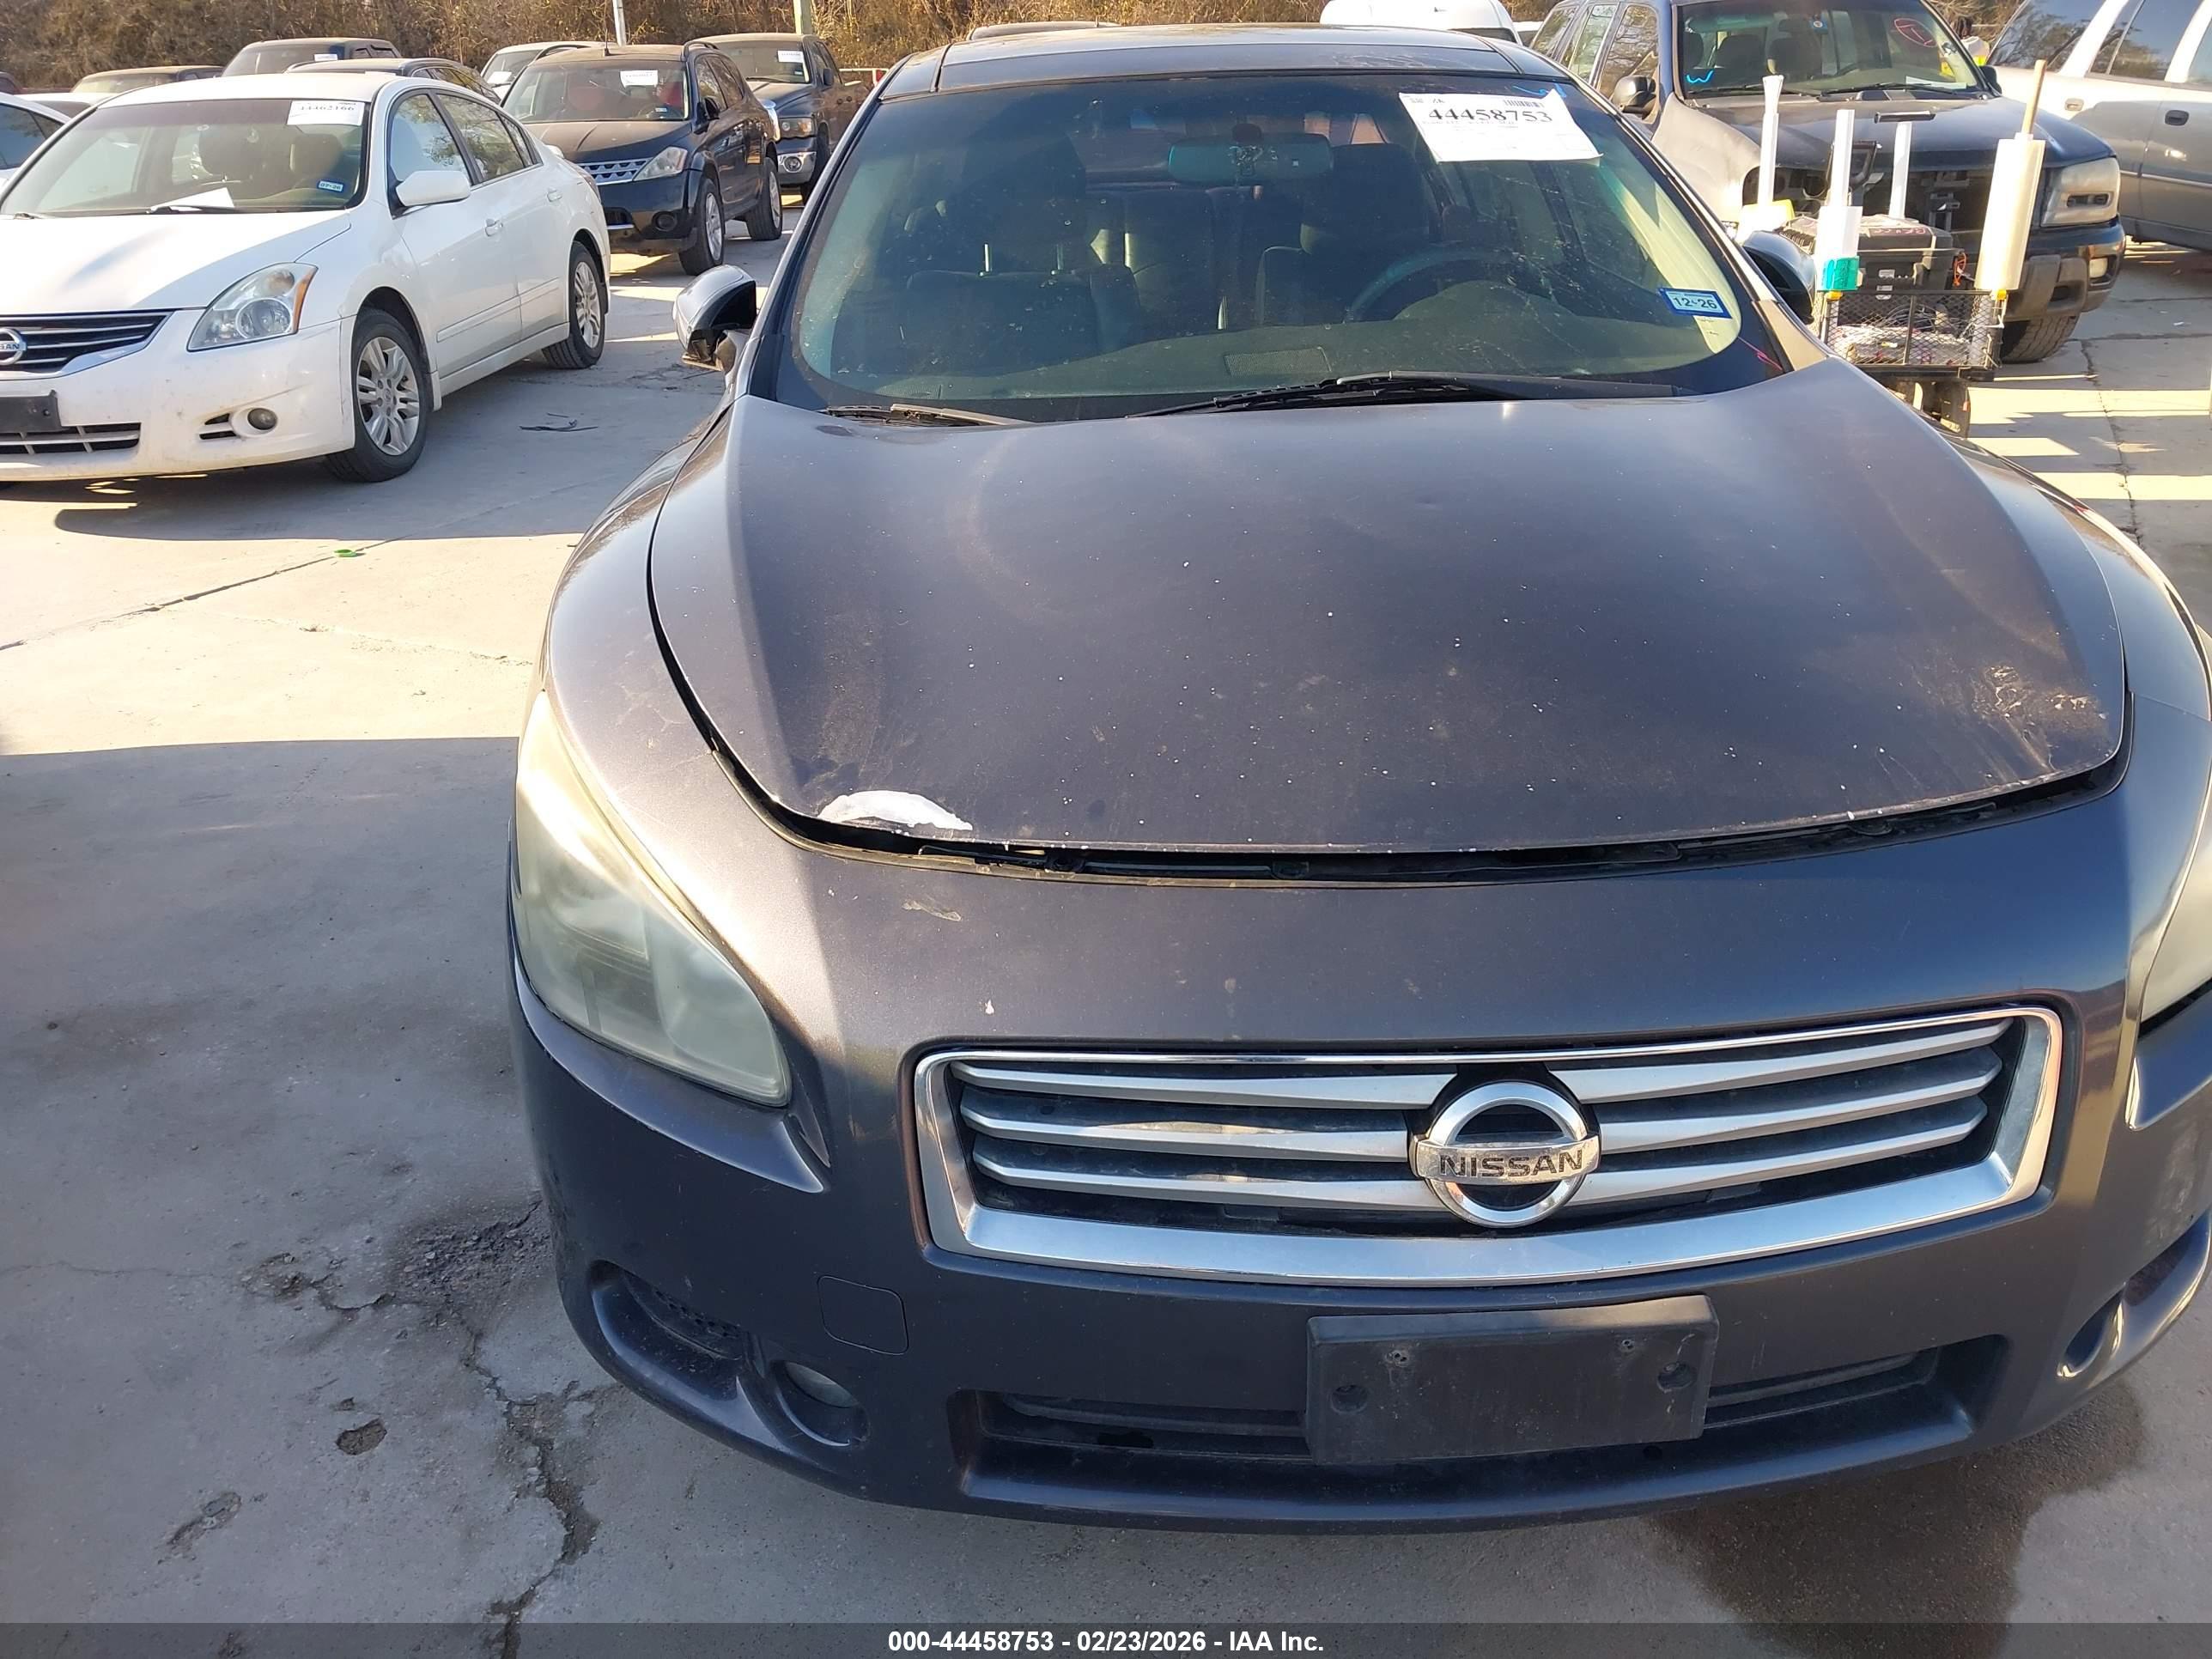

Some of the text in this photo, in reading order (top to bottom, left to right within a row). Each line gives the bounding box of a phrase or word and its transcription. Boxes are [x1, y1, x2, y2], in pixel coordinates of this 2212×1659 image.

[1429, 108, 1553, 123] 44458753
[1673, 297, 1717, 309] 12-26
[1439, 1149, 1583, 1177] NISSAN
